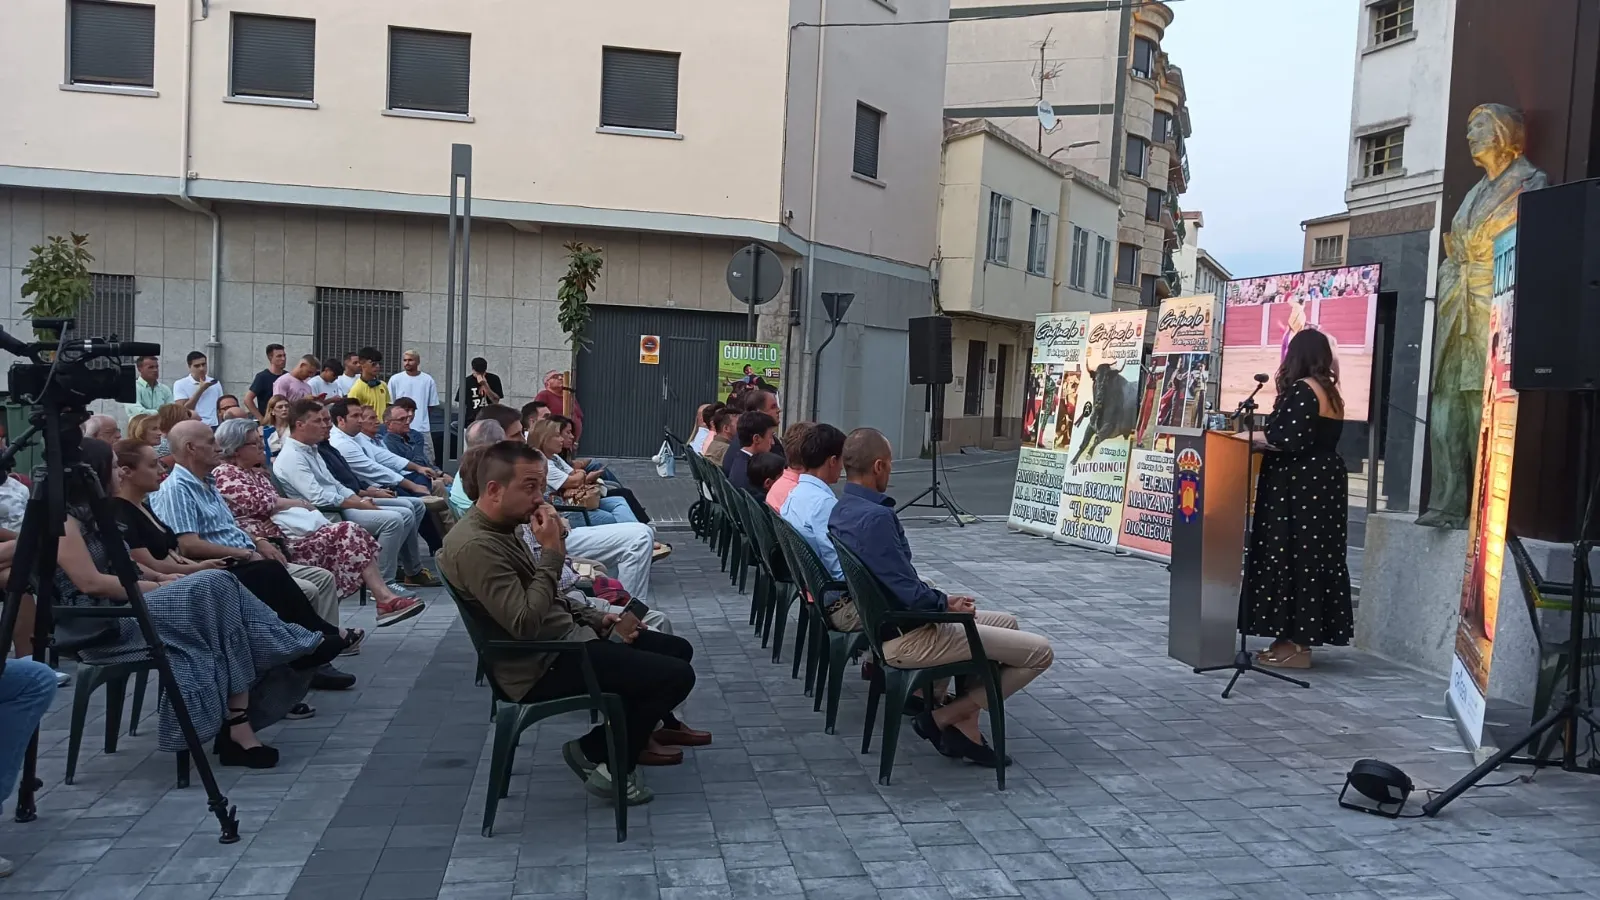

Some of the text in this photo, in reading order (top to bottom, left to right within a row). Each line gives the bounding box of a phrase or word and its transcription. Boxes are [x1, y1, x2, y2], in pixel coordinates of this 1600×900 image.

[1158, 306, 1204, 339] Guijuelo
[1036, 321, 1078, 347] Guijuelo
[1089, 322, 1134, 351] Guijuelo
[725, 345, 776, 361] GUIJUELO
[765, 368, 772, 377] 18
[1083, 481, 1124, 502] ESCRIBANO
[1152, 476, 1174, 493] FAN
[1031, 487, 1060, 507] PERERA
[1127, 491, 1174, 514] MANZANA
[1061, 517, 1112, 544] JOSÉ GARRIDO
[1125, 520, 1172, 542] DIOSLEGUA
